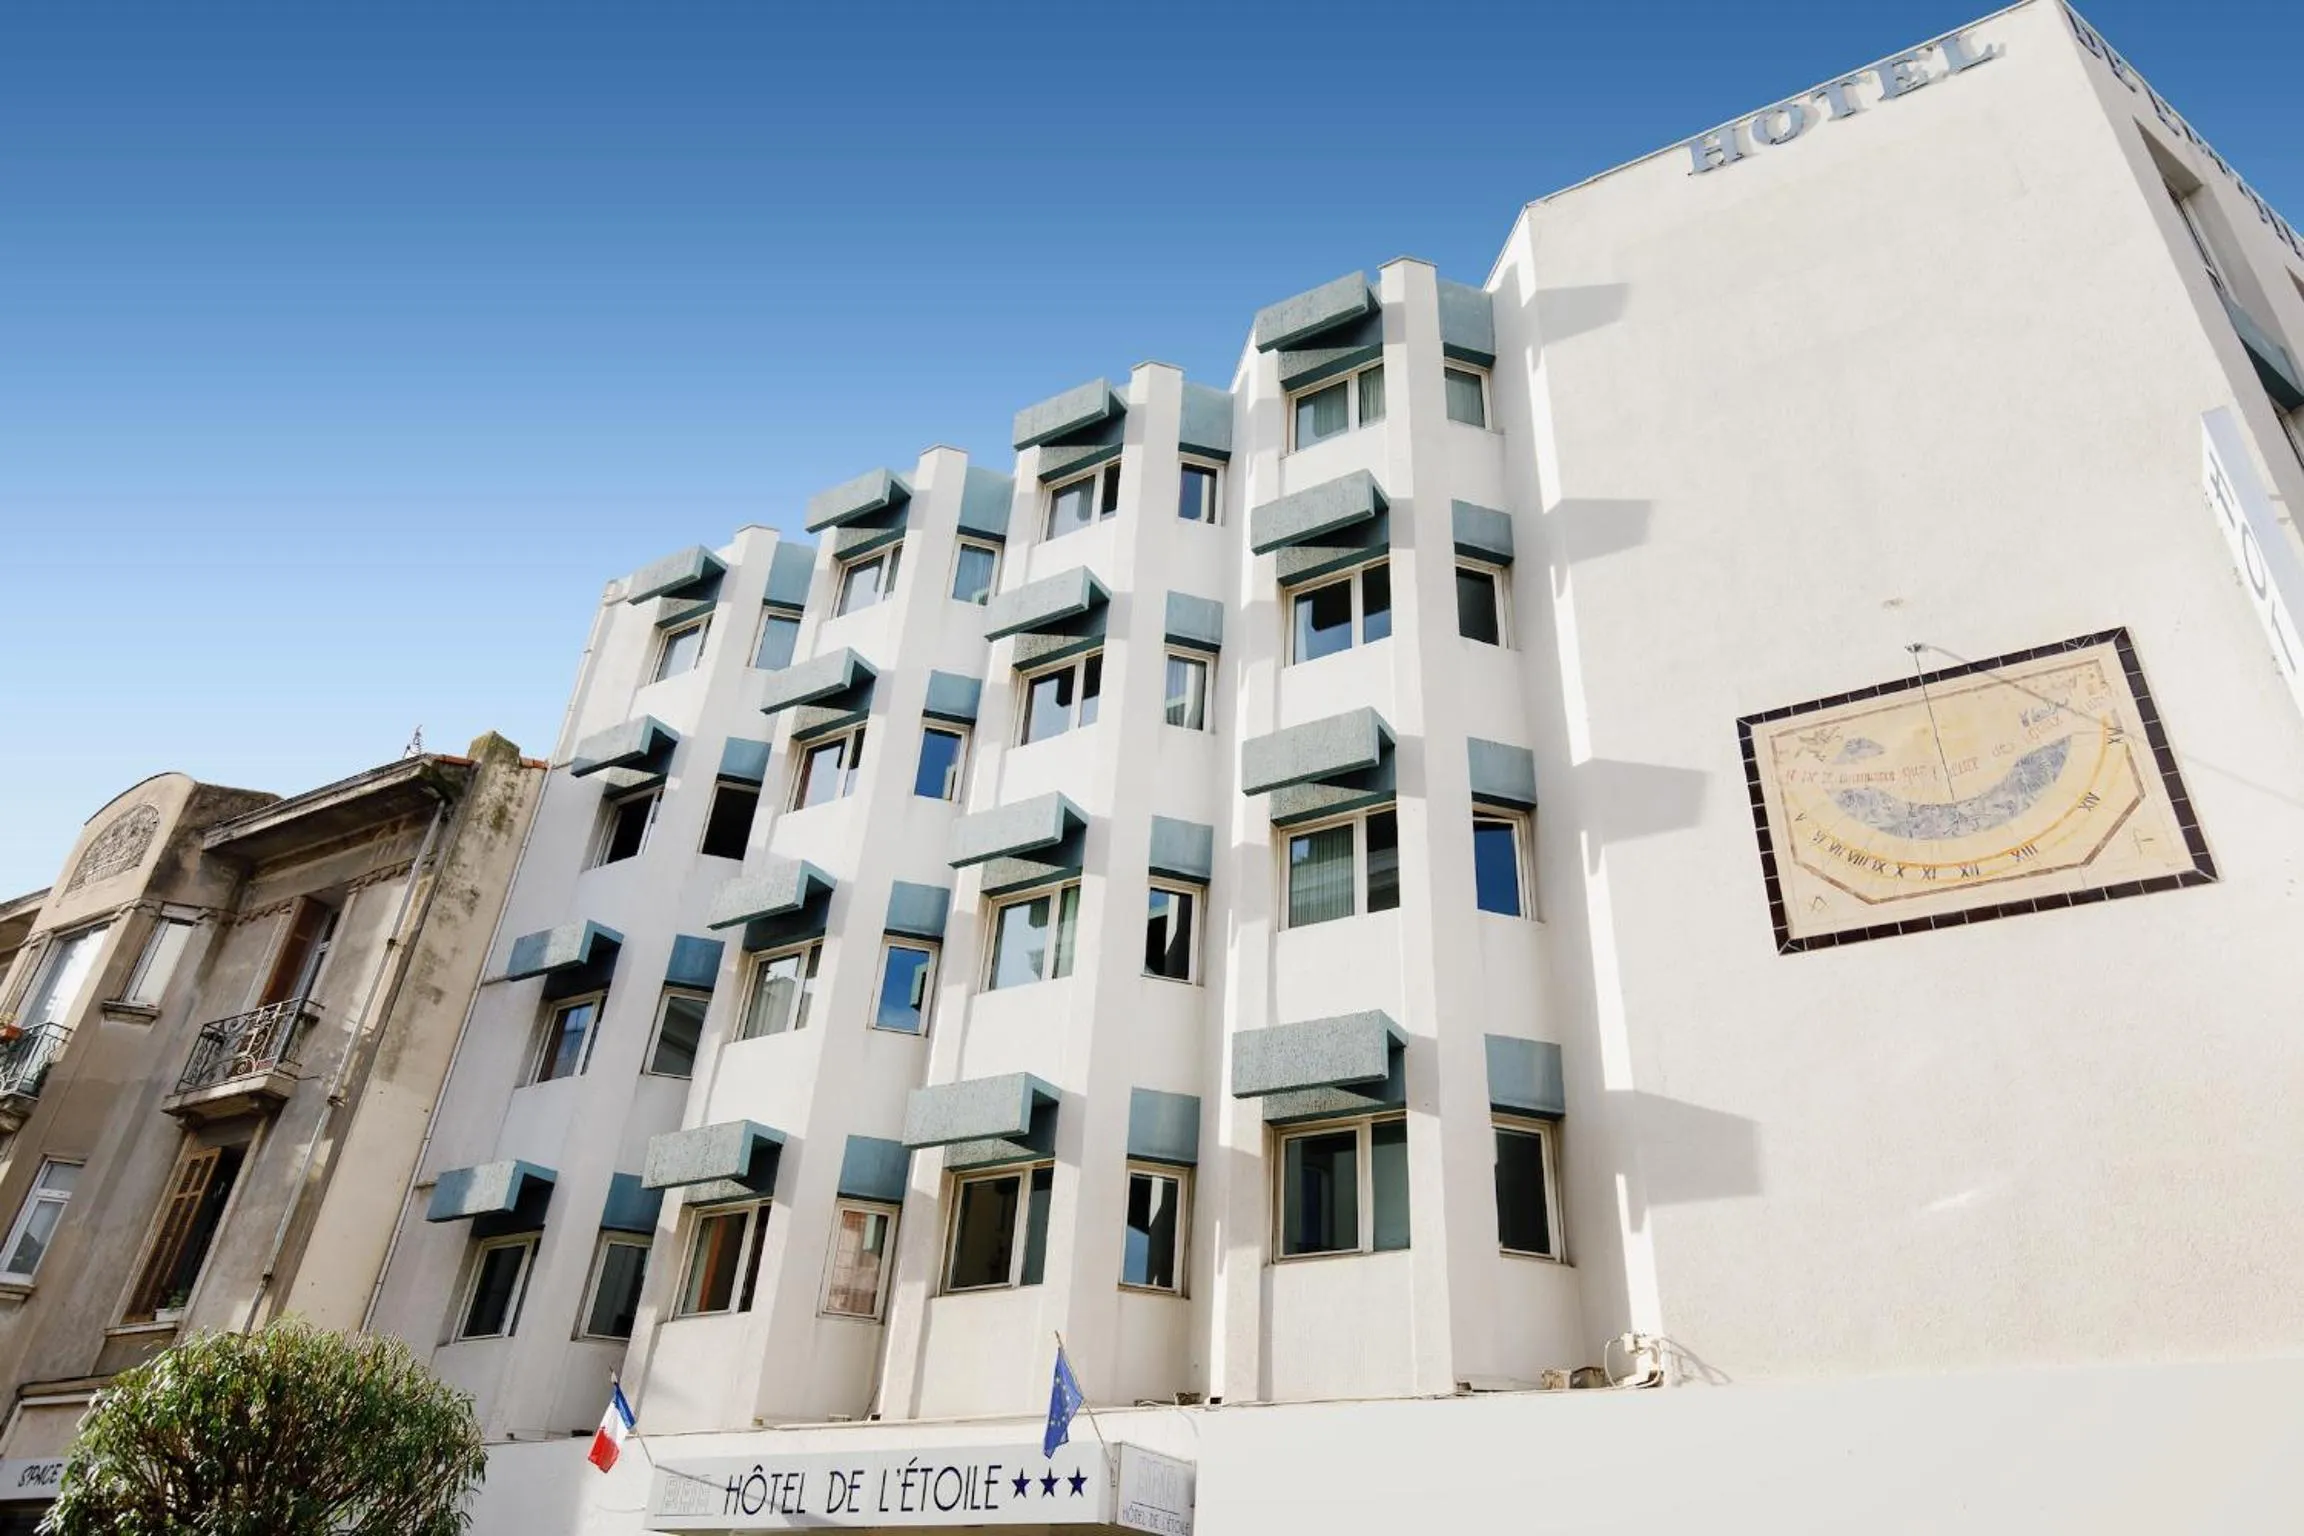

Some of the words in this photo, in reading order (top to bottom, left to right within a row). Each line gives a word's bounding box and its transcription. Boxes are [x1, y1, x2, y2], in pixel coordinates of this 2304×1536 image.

[1687, 33, 2002, 174] HOTEL
[1848, 850, 1868, 867] VIII
[1871, 860, 1887, 875] IX
[1896, 863, 1906, 878] X
[1922, 866, 1937, 881] XI
[1960, 863, 1980, 879] XII
[2010, 844, 2038, 862] XIII
[2078, 792, 2100, 812] XIV
[723, 1464, 806, 1516] HÔTEL
[826, 1470, 865, 1514] DE
[878, 1456, 1002, 1512] L'ÉTOILE
[1122, 1504, 1146, 1526] HÔTEL
[1148, 1512, 1160, 1530] DE
